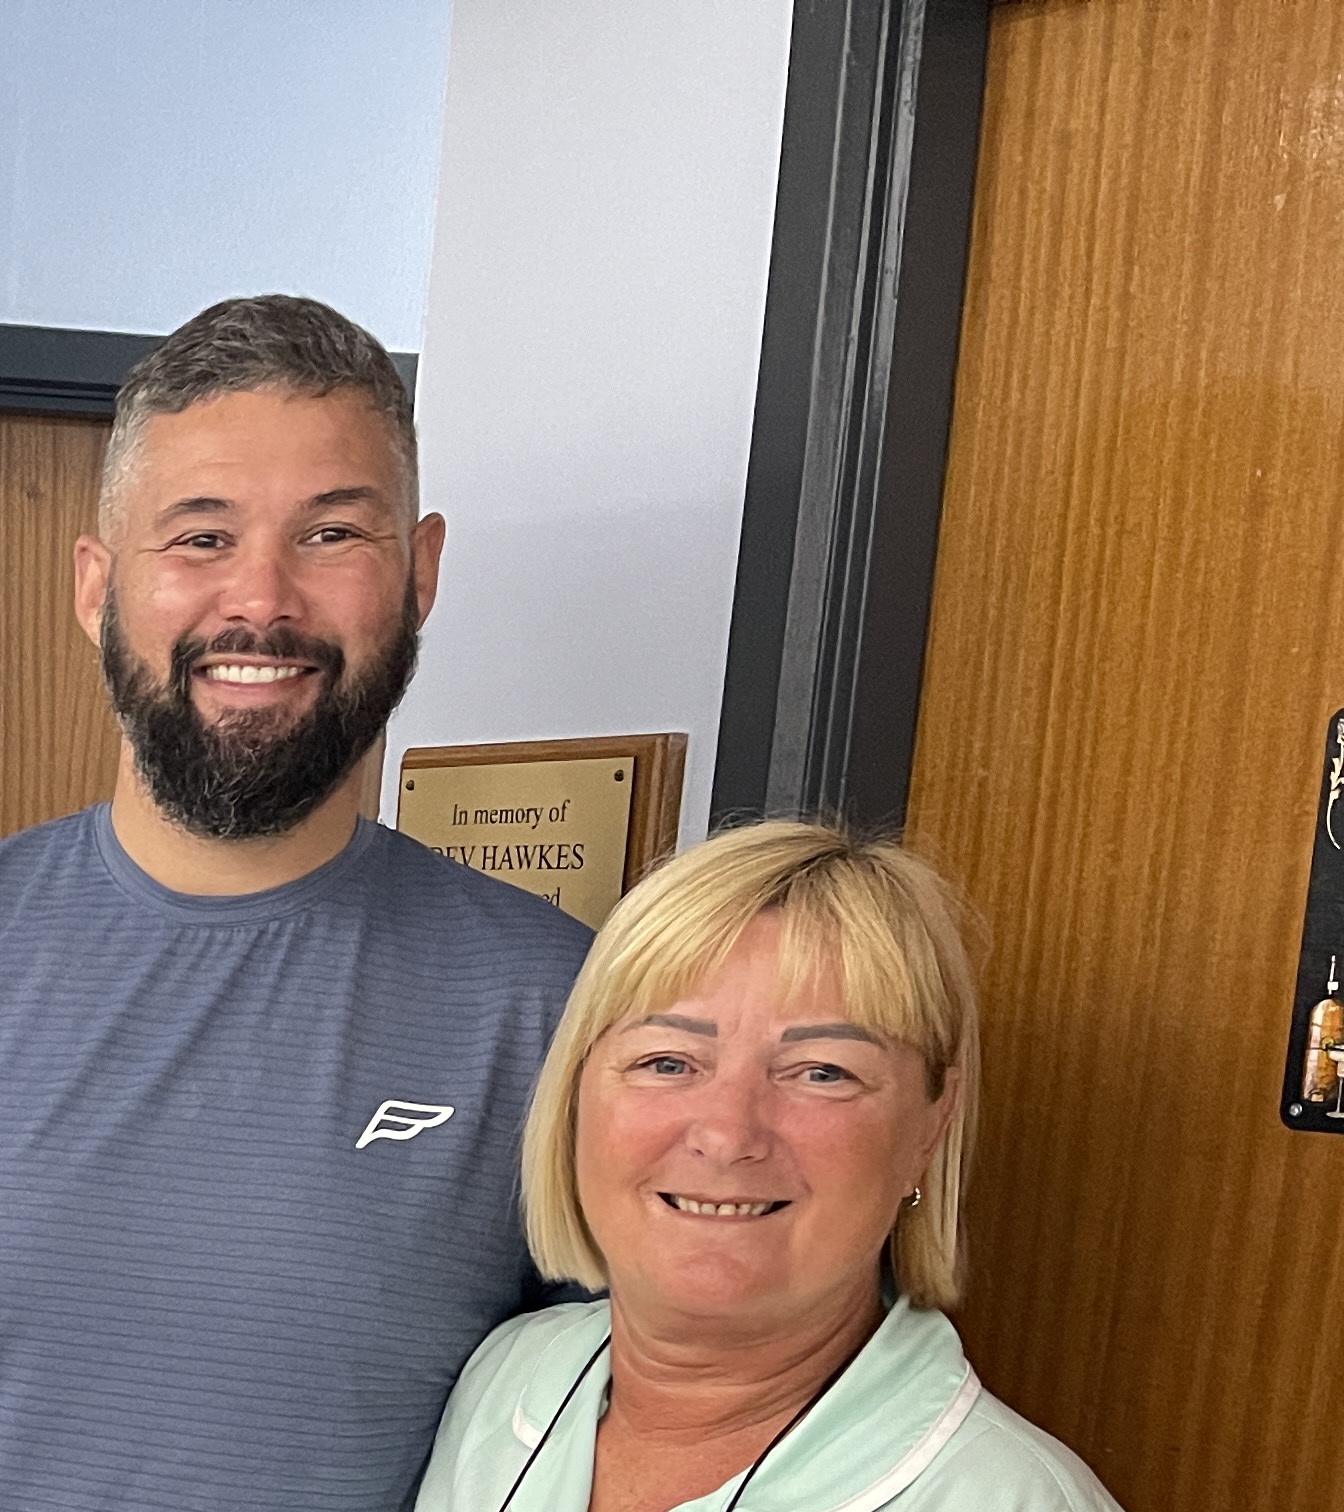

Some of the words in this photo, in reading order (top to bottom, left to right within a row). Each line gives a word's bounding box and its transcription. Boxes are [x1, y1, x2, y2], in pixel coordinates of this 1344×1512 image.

[452, 803, 468, 826] In
[474, 807, 544, 830] memory
[548, 799, 571, 823] of
[481, 843, 585, 871] HAWKES
